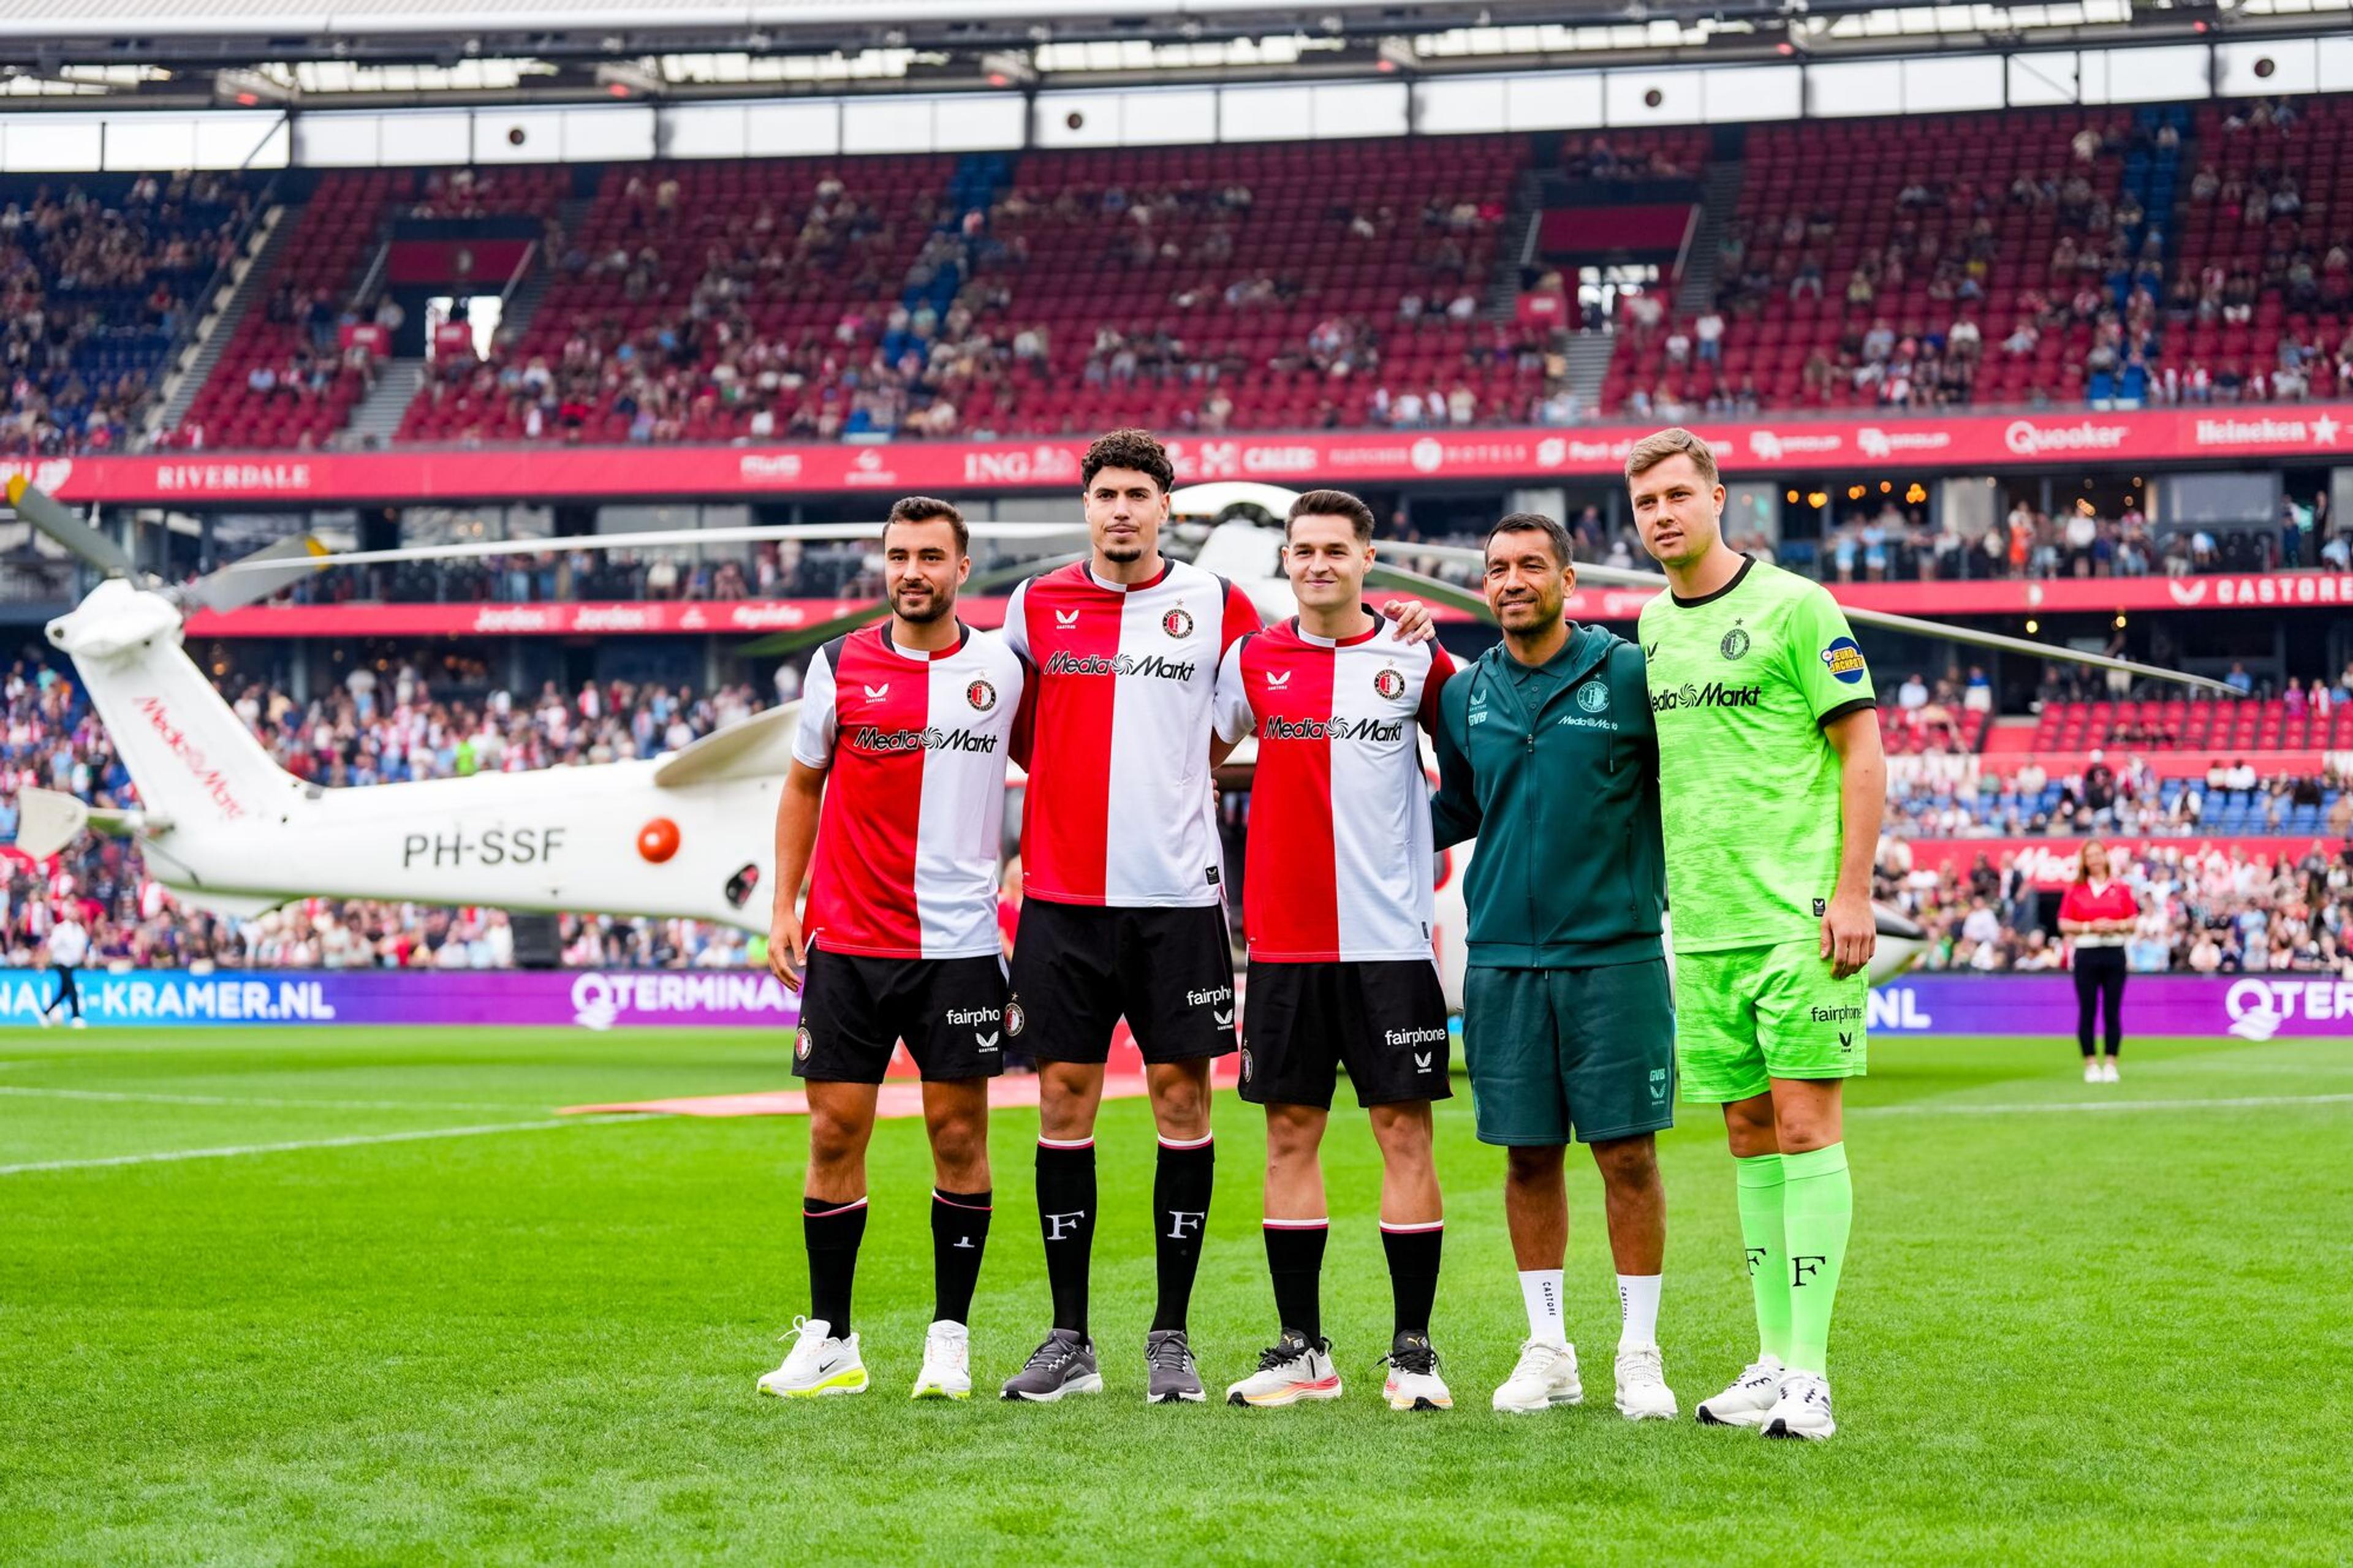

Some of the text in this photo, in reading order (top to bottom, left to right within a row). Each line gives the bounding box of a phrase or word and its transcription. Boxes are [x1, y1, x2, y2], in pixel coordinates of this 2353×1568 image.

[2005, 420, 2125, 455] Quooker
[2196, 419, 2307, 445] Heineken
[157, 464, 310, 489] RIVERDALE
[964, 450, 1029, 483] ING
[2216, 577, 2353, 604] CASTORE
[1044, 651, 1195, 682] Media Markt
[1650, 682, 1762, 713] edia Markt
[854, 727, 998, 754] Media Markt
[1264, 716, 1403, 741] Media Markt
[404, 827, 566, 868] PH-SSF
[1385, 1027, 1446, 1047] fairphone
[1045, 1210, 1085, 1240] F
[1167, 1211, 1205, 1239] F
[1792, 1256, 1826, 1287] F
[1542, 1281, 1556, 1316] CASTORE
